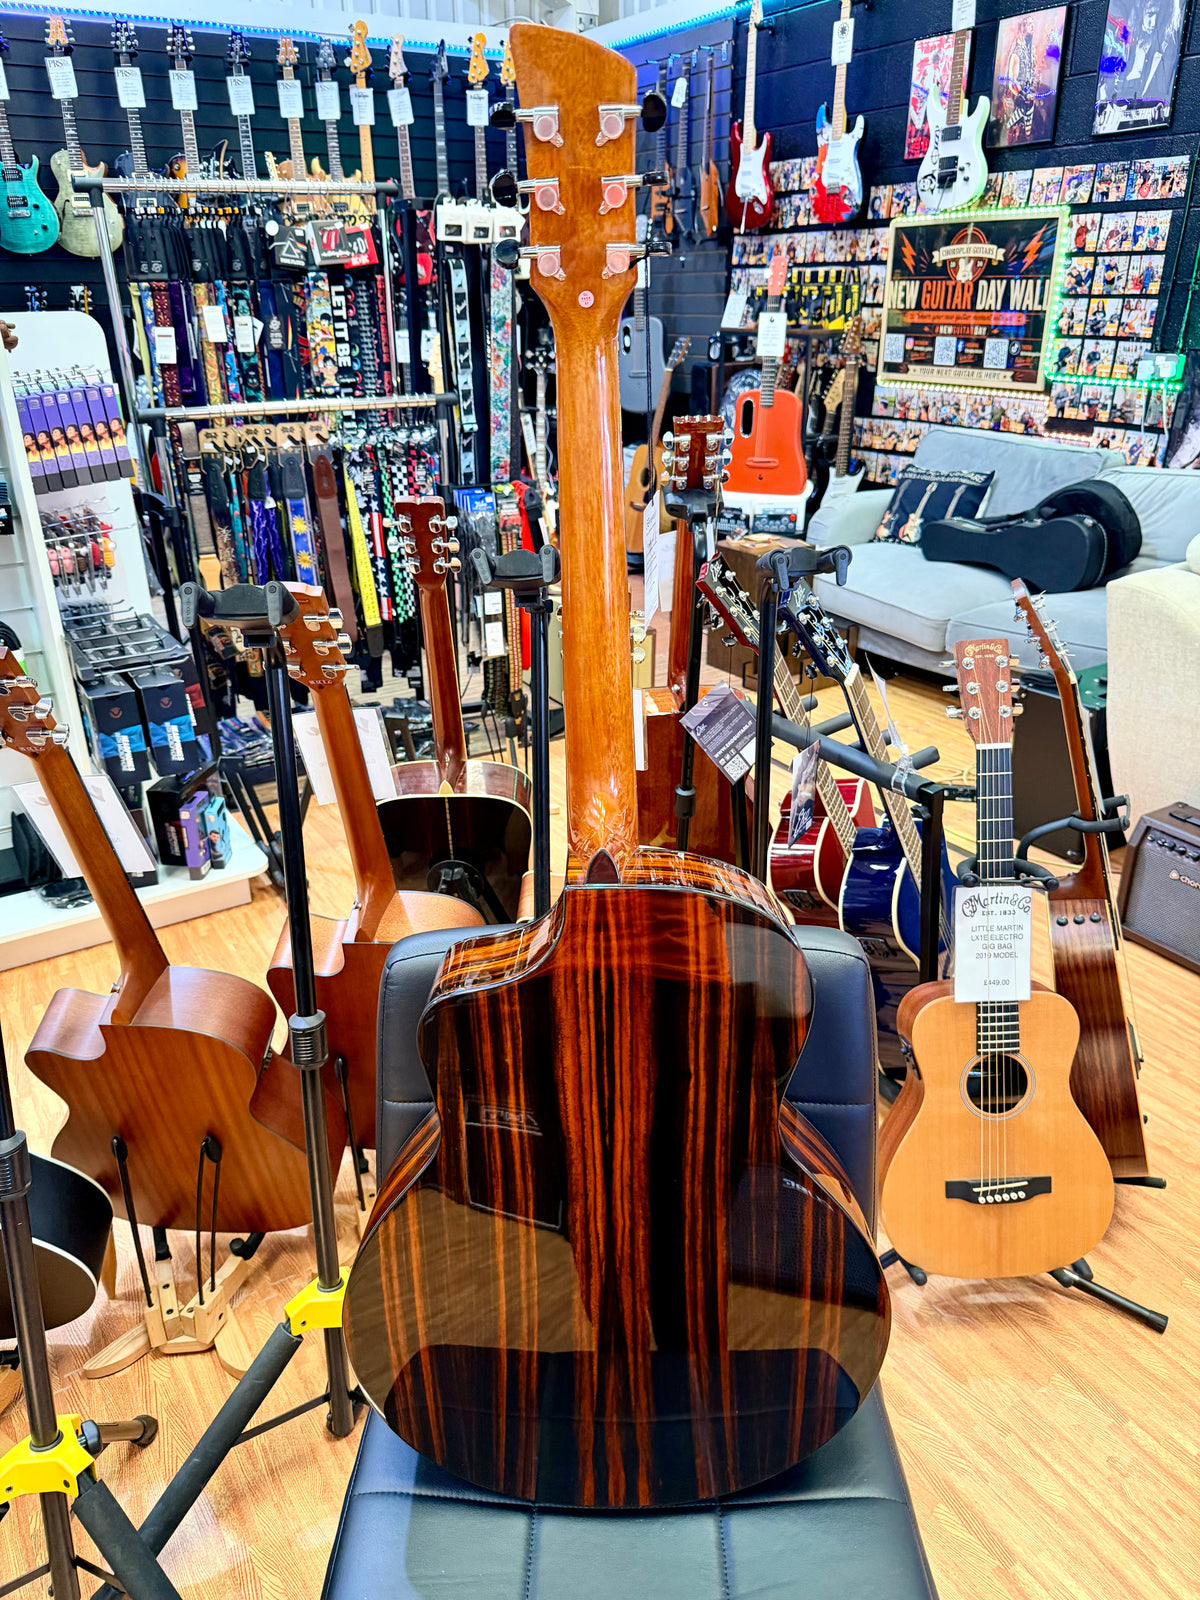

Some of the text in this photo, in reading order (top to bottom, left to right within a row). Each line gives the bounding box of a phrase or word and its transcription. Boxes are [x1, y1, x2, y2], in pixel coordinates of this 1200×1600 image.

[330, 284, 348, 320] LET
[888, 280, 920, 309] NEW
[921, 280, 974, 310] GUITAR
[976, 279, 1007, 311] DAY
[334, 322, 349, 341] IT
[336, 343, 351, 368] BE
[970, 892, 1010, 910] Martin
[990, 933, 1024, 941] ELECTRO
[997, 924, 1023, 932] MARTIN
